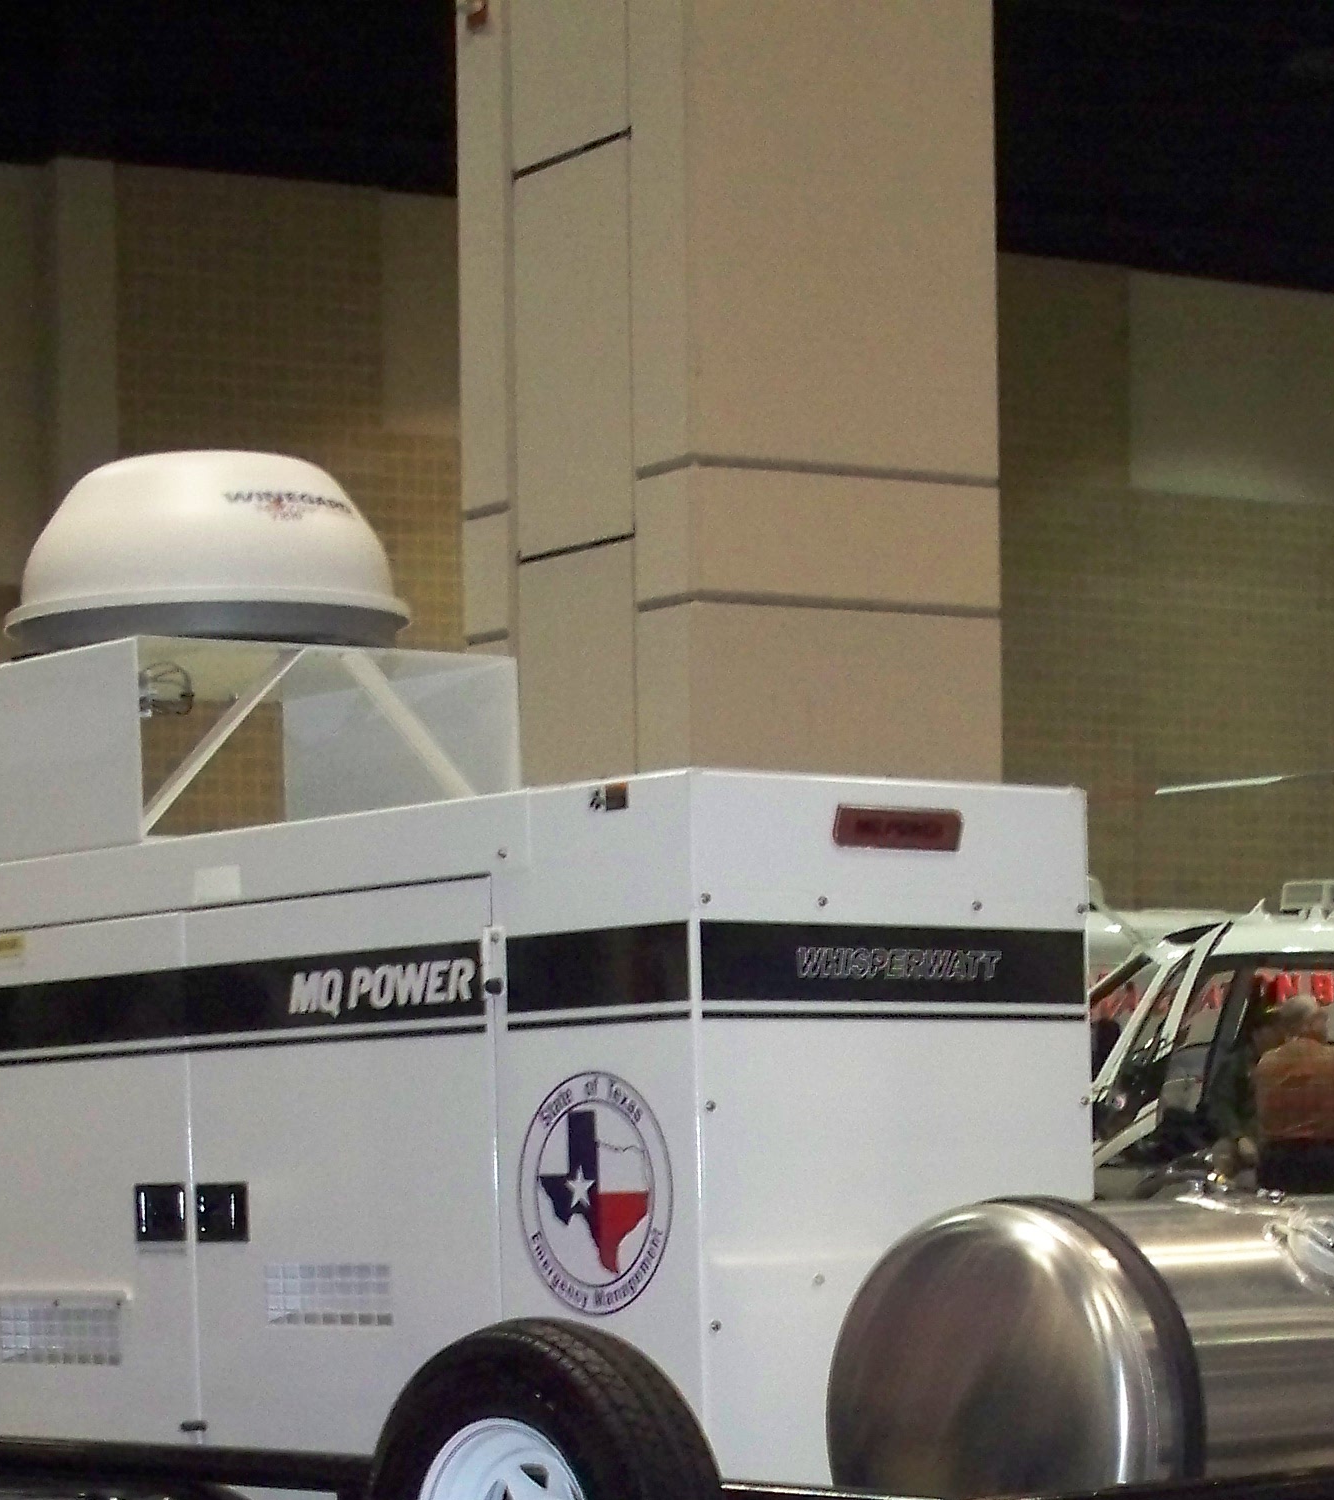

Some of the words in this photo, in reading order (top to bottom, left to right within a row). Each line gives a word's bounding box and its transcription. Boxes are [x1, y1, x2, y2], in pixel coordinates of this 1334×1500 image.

[288, 967, 345, 1019] MQ
[347, 957, 477, 1011] POWER
[796, 945, 1004, 982] WHISPERWATT
[541, 1088, 573, 1128] State
[584, 1077, 599, 1097] of
[608, 1078, 644, 1123] Texas
[531, 1230, 589, 1309] Emergency
[593, 1227, 664, 1307] Management
